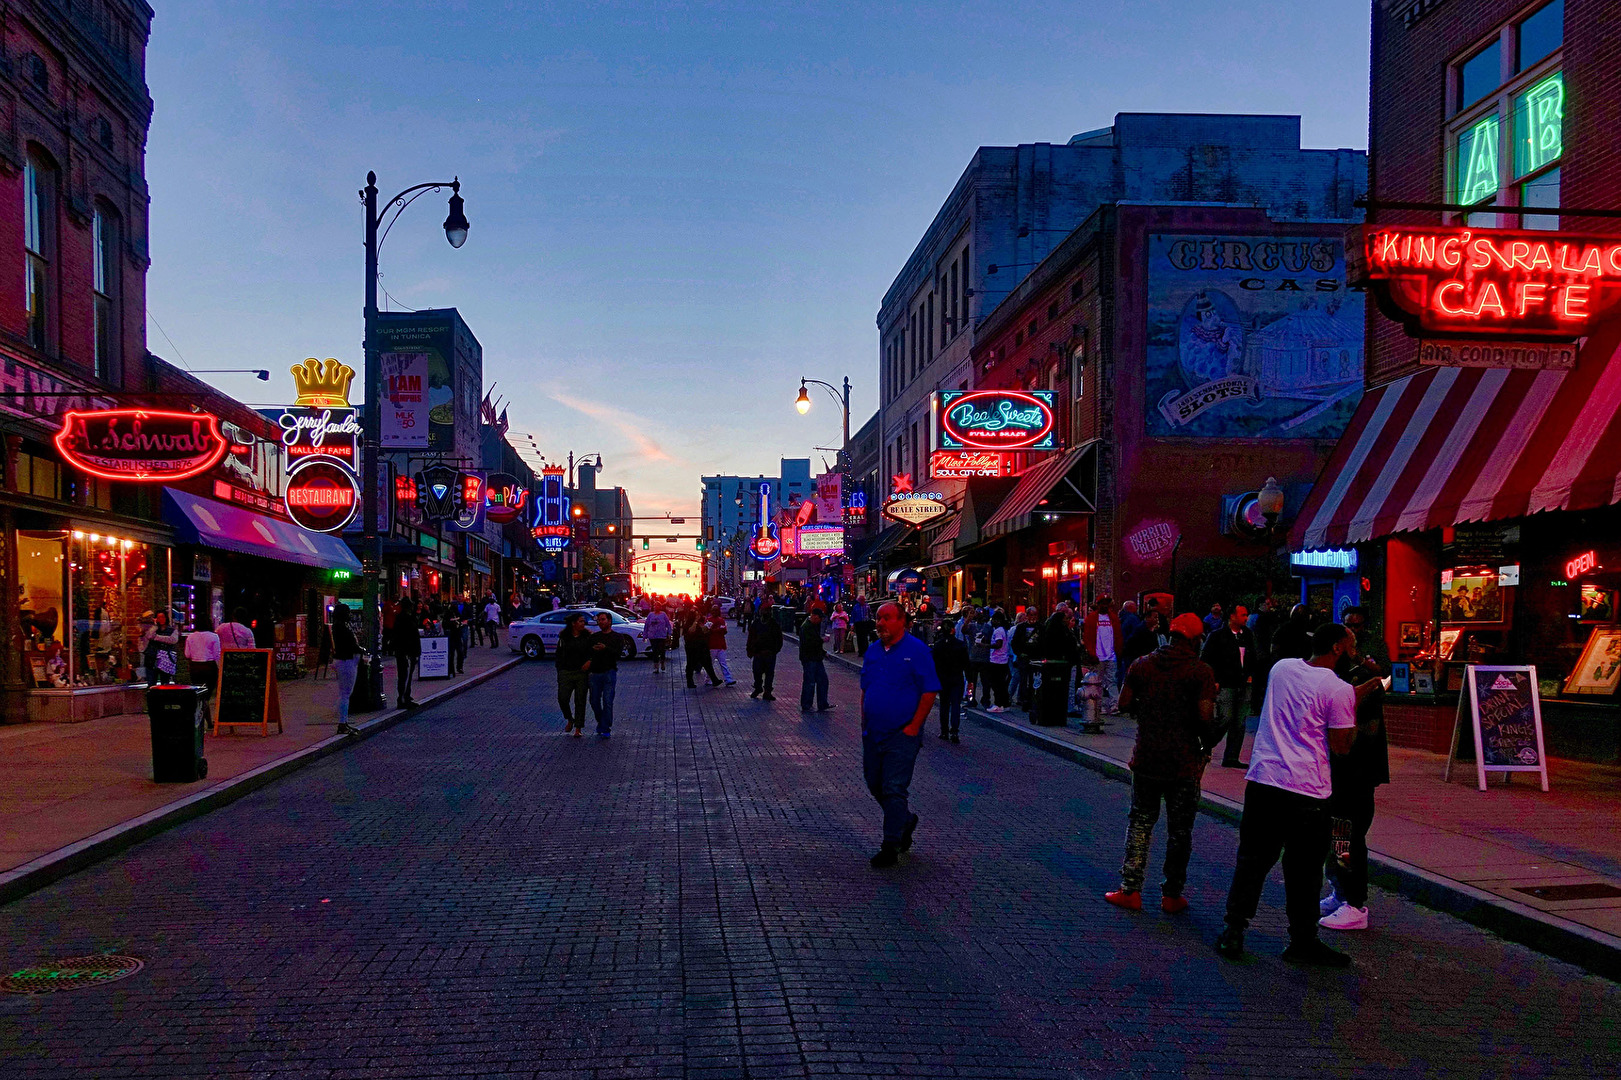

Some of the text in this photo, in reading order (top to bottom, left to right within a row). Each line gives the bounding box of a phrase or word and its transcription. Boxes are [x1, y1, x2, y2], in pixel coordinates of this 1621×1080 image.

[1167, 239, 1335, 272] CIRCUS
[1382, 231, 1492, 268] KING'S
[1439, 284, 1590, 317] CAFE
[1460, 347, 1572, 364] CONDITIONED
[399, 375, 422, 391] AM
[1179, 386, 1248, 419] SLOTS!
[101, 418, 212, 451] Schwab
[290, 446, 352, 456] HALL OF FAME
[94, 457, 193, 471] ESTABLISHED 1876
[936, 469, 998, 477] SOUL CITY CAFE
[289, 488, 353, 506] RESTAURANT
[485, 484, 529, 509] emphis
[890, 505, 943, 514] BEALE STREET
[536, 526, 570, 536] KING'S
[1129, 522, 1172, 552] BURRITO
[545, 537, 562, 547] BLUES
[1139, 535, 1169, 554] BLUES
[1566, 551, 1595, 579] OPEN
[1481, 697, 1529, 731] SPECIAL
